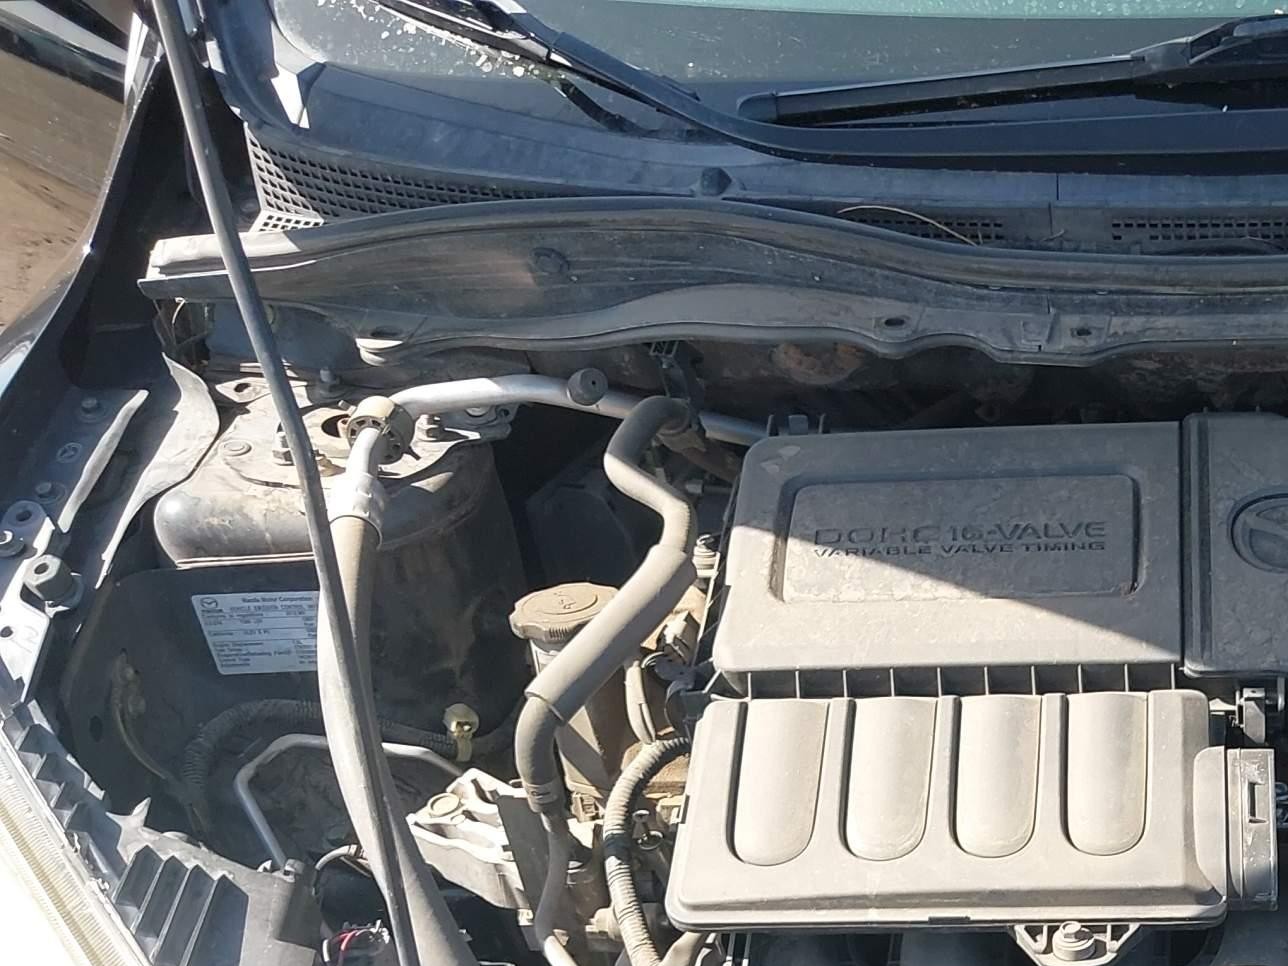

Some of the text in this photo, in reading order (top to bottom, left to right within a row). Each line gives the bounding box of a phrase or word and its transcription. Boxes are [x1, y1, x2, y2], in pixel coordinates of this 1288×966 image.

[815, 520, 1107, 546] DOHC 16-VALVE
[814, 540, 1106, 558] VARIABLE VALVE TIMING
